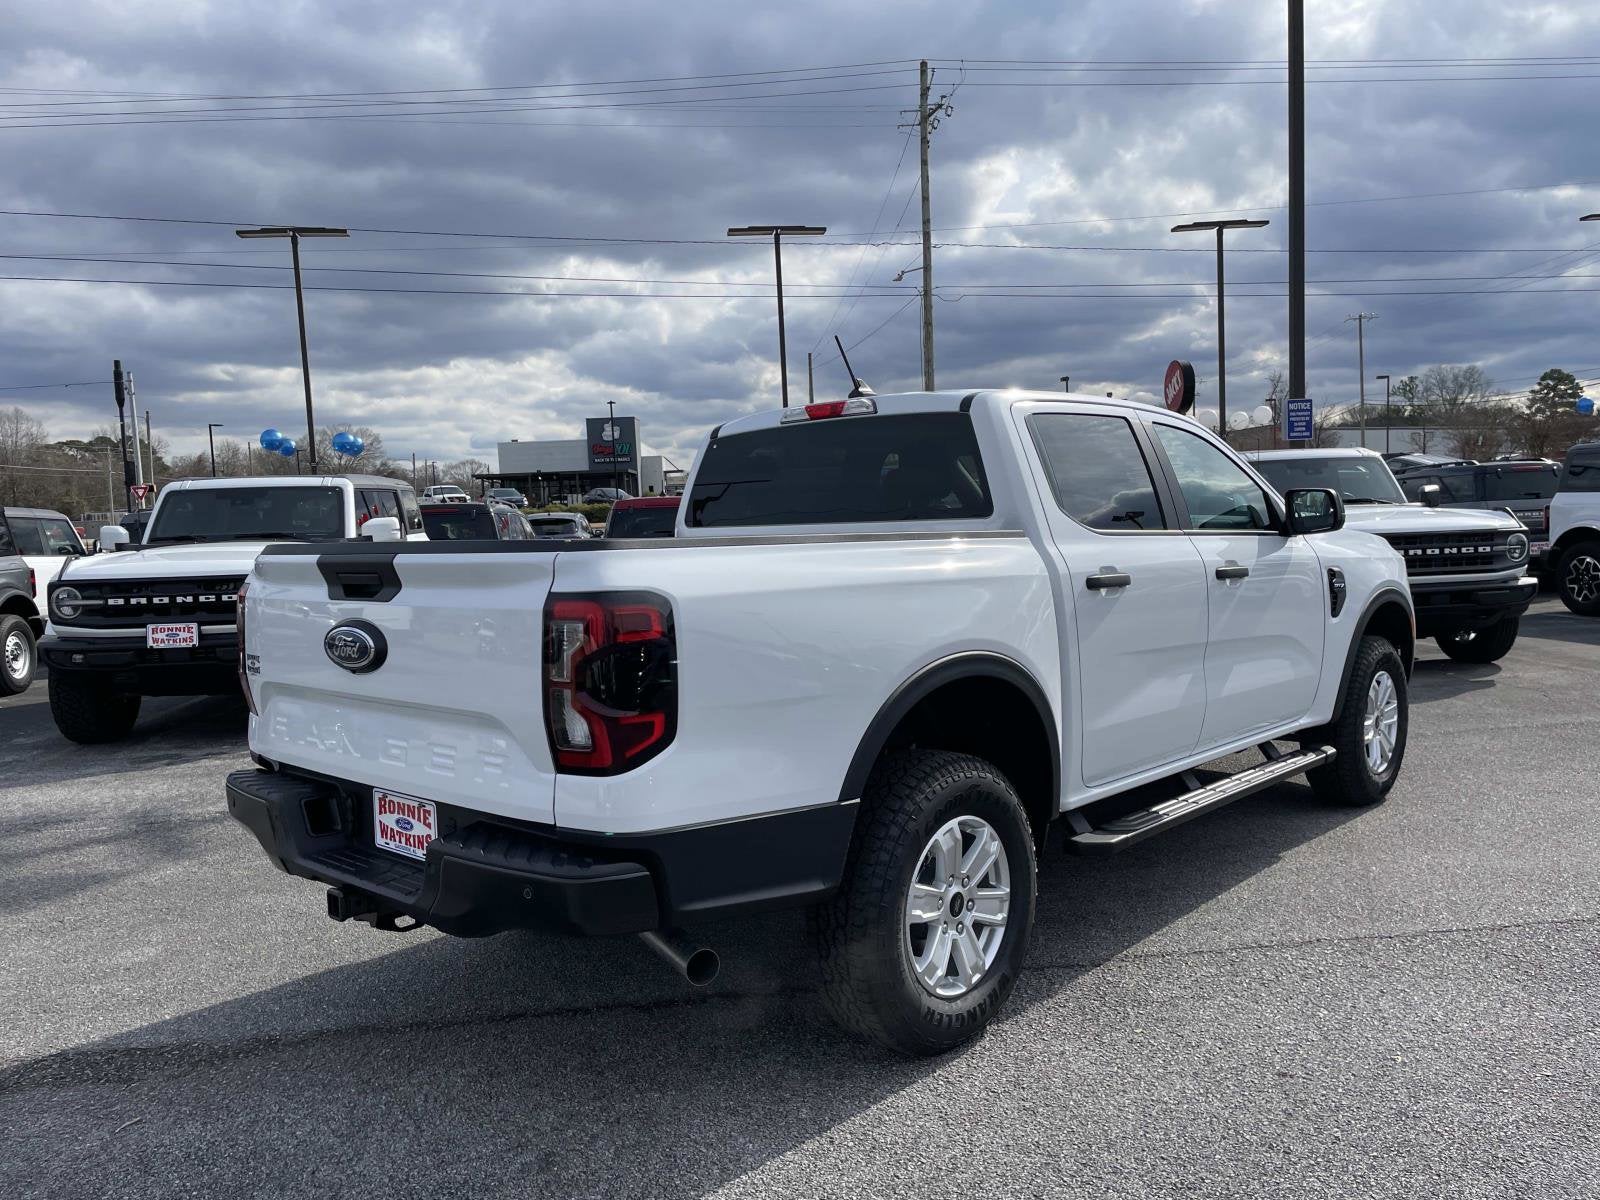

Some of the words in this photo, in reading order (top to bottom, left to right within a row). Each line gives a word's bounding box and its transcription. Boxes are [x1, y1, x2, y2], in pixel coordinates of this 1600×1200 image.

[1289, 402, 1311, 410] NOTICE
[107, 594, 238, 606] BRONCO
[151, 625, 194, 635] RONNIE
[151, 635, 194, 645] WATKINS
[332, 634, 360, 659] Ford
[378, 794, 432, 830] RONNIE
[378, 819, 433, 852] WATKINS
